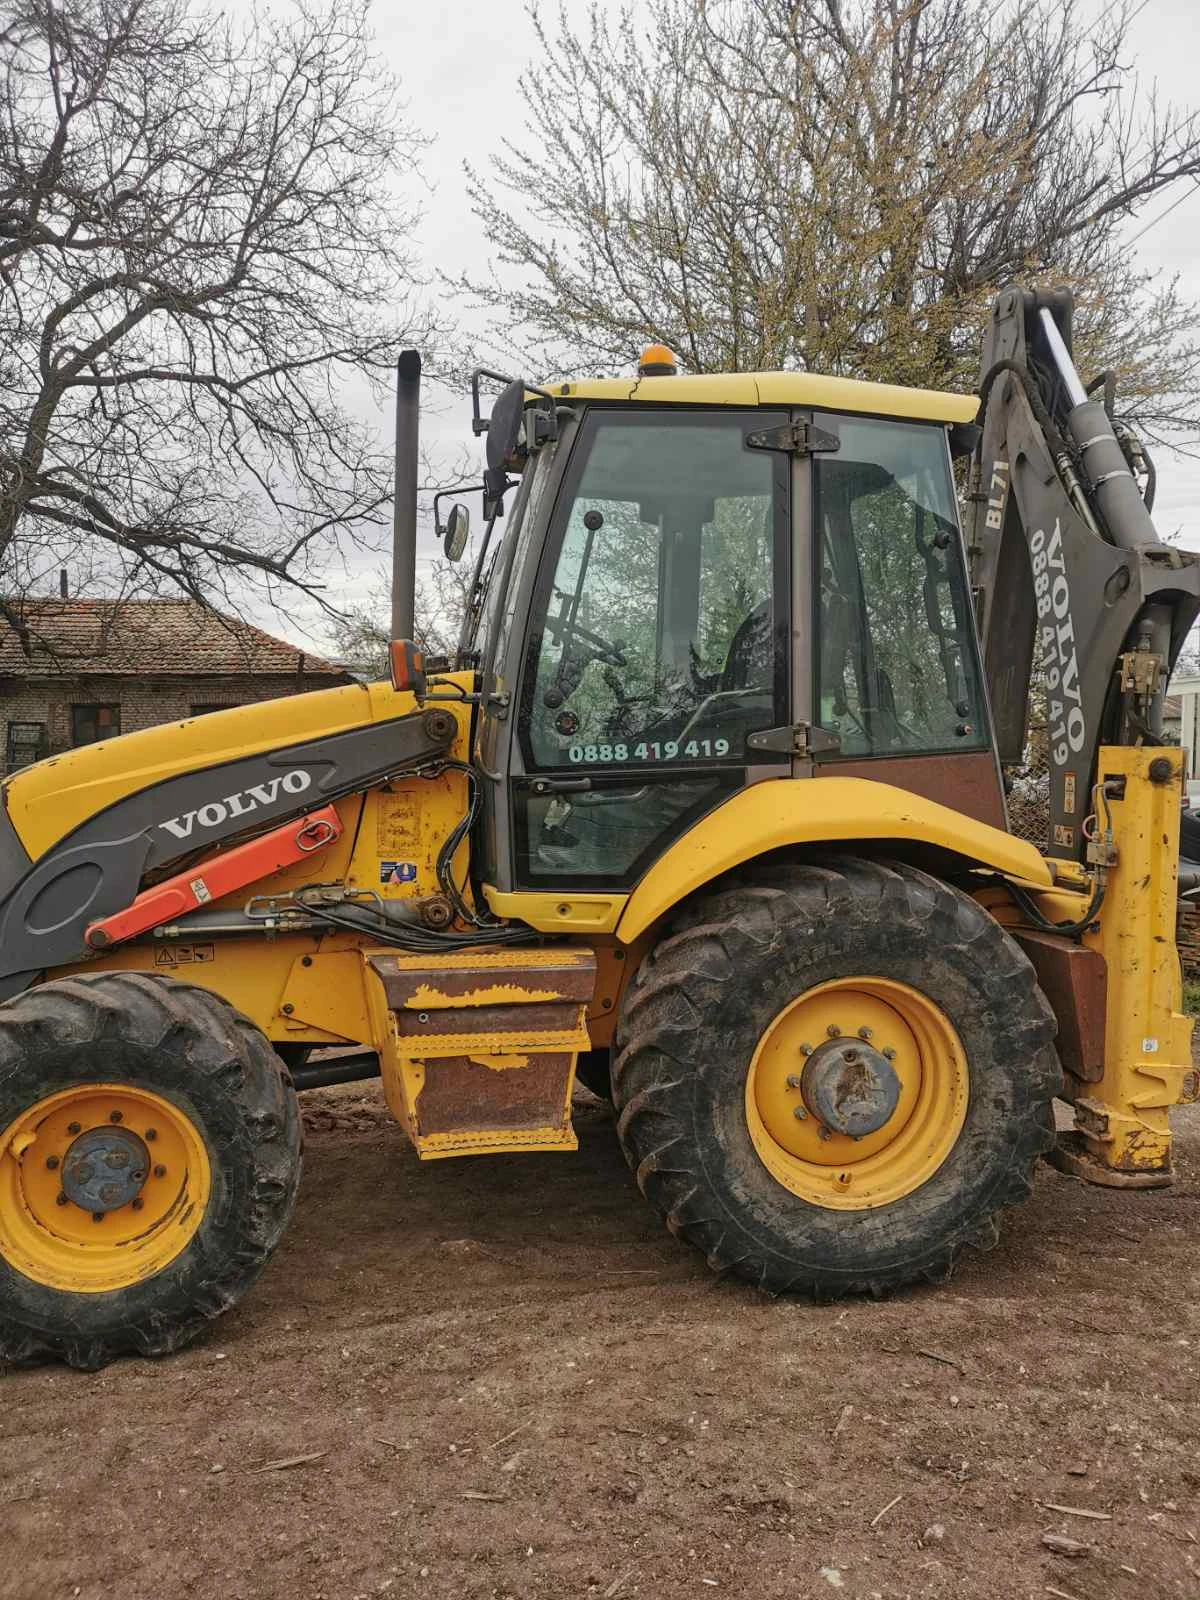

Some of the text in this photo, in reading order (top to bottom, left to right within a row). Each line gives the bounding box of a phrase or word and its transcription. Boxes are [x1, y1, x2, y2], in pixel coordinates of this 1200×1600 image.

[985, 461, 1009, 529] BL71
[1031, 529, 1069, 765] 0888 419 419
[1047, 517, 1085, 752] VOLVO
[568, 738, 730, 763] 0888 419 419
[158, 769, 312, 839] VOLVO
